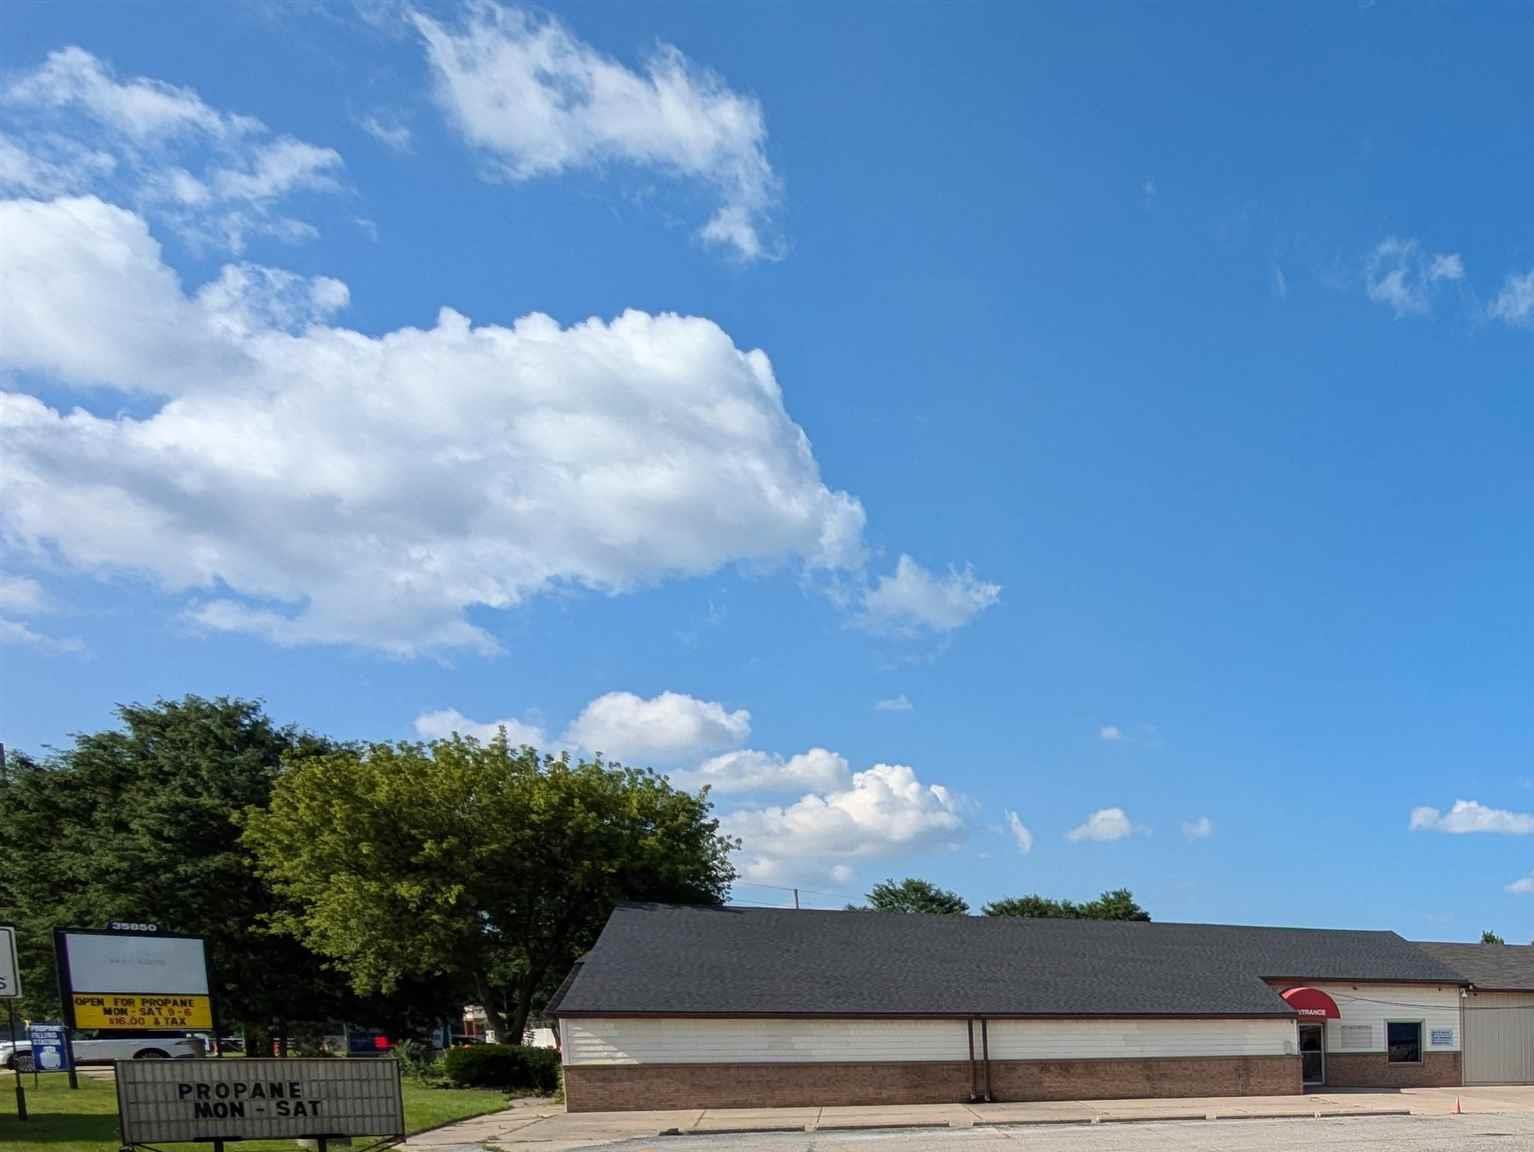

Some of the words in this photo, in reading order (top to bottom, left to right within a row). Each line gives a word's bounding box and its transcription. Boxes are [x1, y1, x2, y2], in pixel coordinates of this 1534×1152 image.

[75, 998, 104, 1006] OPEN
[142, 999, 194, 1007] PROPANE
[103, 1007, 128, 1015] MON
[139, 1008, 162, 1016] SAT
[178, 1082, 302, 1100] PROPANE
[194, 1101, 245, 1119] MON
[275, 1100, 321, 1117] SAT
